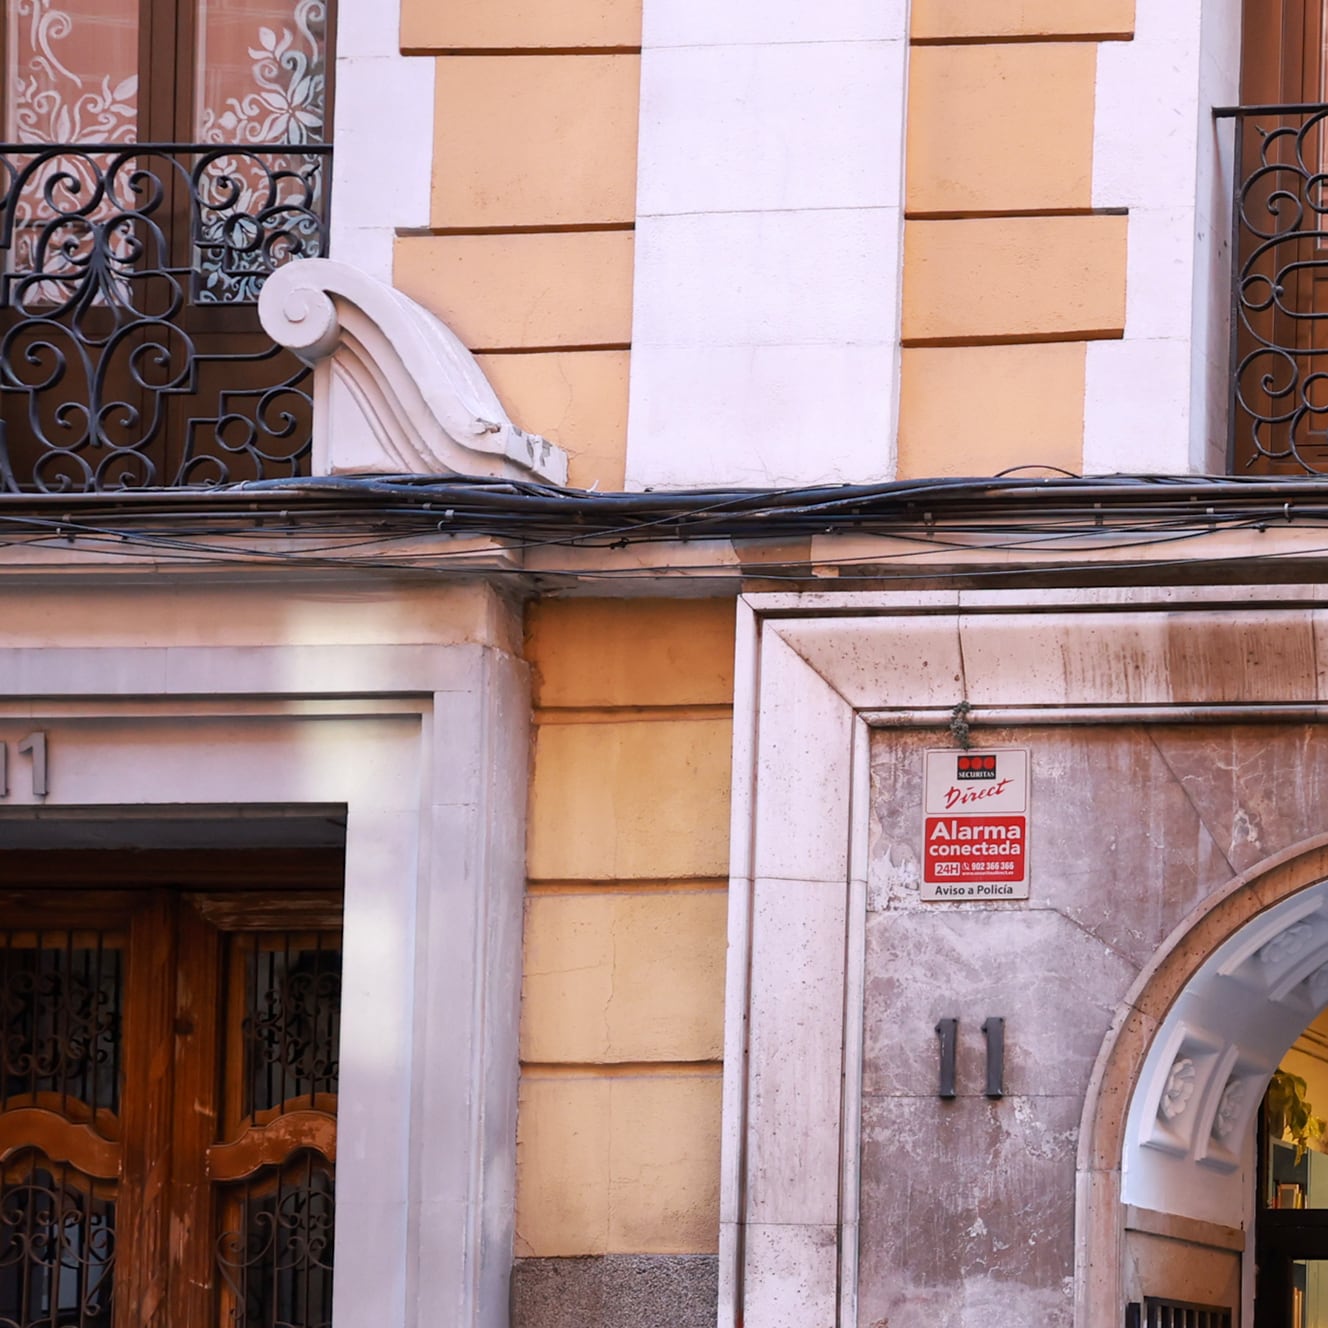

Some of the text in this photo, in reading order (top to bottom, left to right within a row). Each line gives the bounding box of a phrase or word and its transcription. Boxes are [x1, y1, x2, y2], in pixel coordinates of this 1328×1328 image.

[958, 770, 995, 778] SECURITAS
[944, 778, 1014, 809] Direct
[930, 820, 1020, 840] Alarma
[929, 840, 1021, 856] conectada
[936, 861, 1014, 875] 24H 902 366 366
[935, 885, 965, 895] Aviso
[977, 883, 1013, 895] Policía
